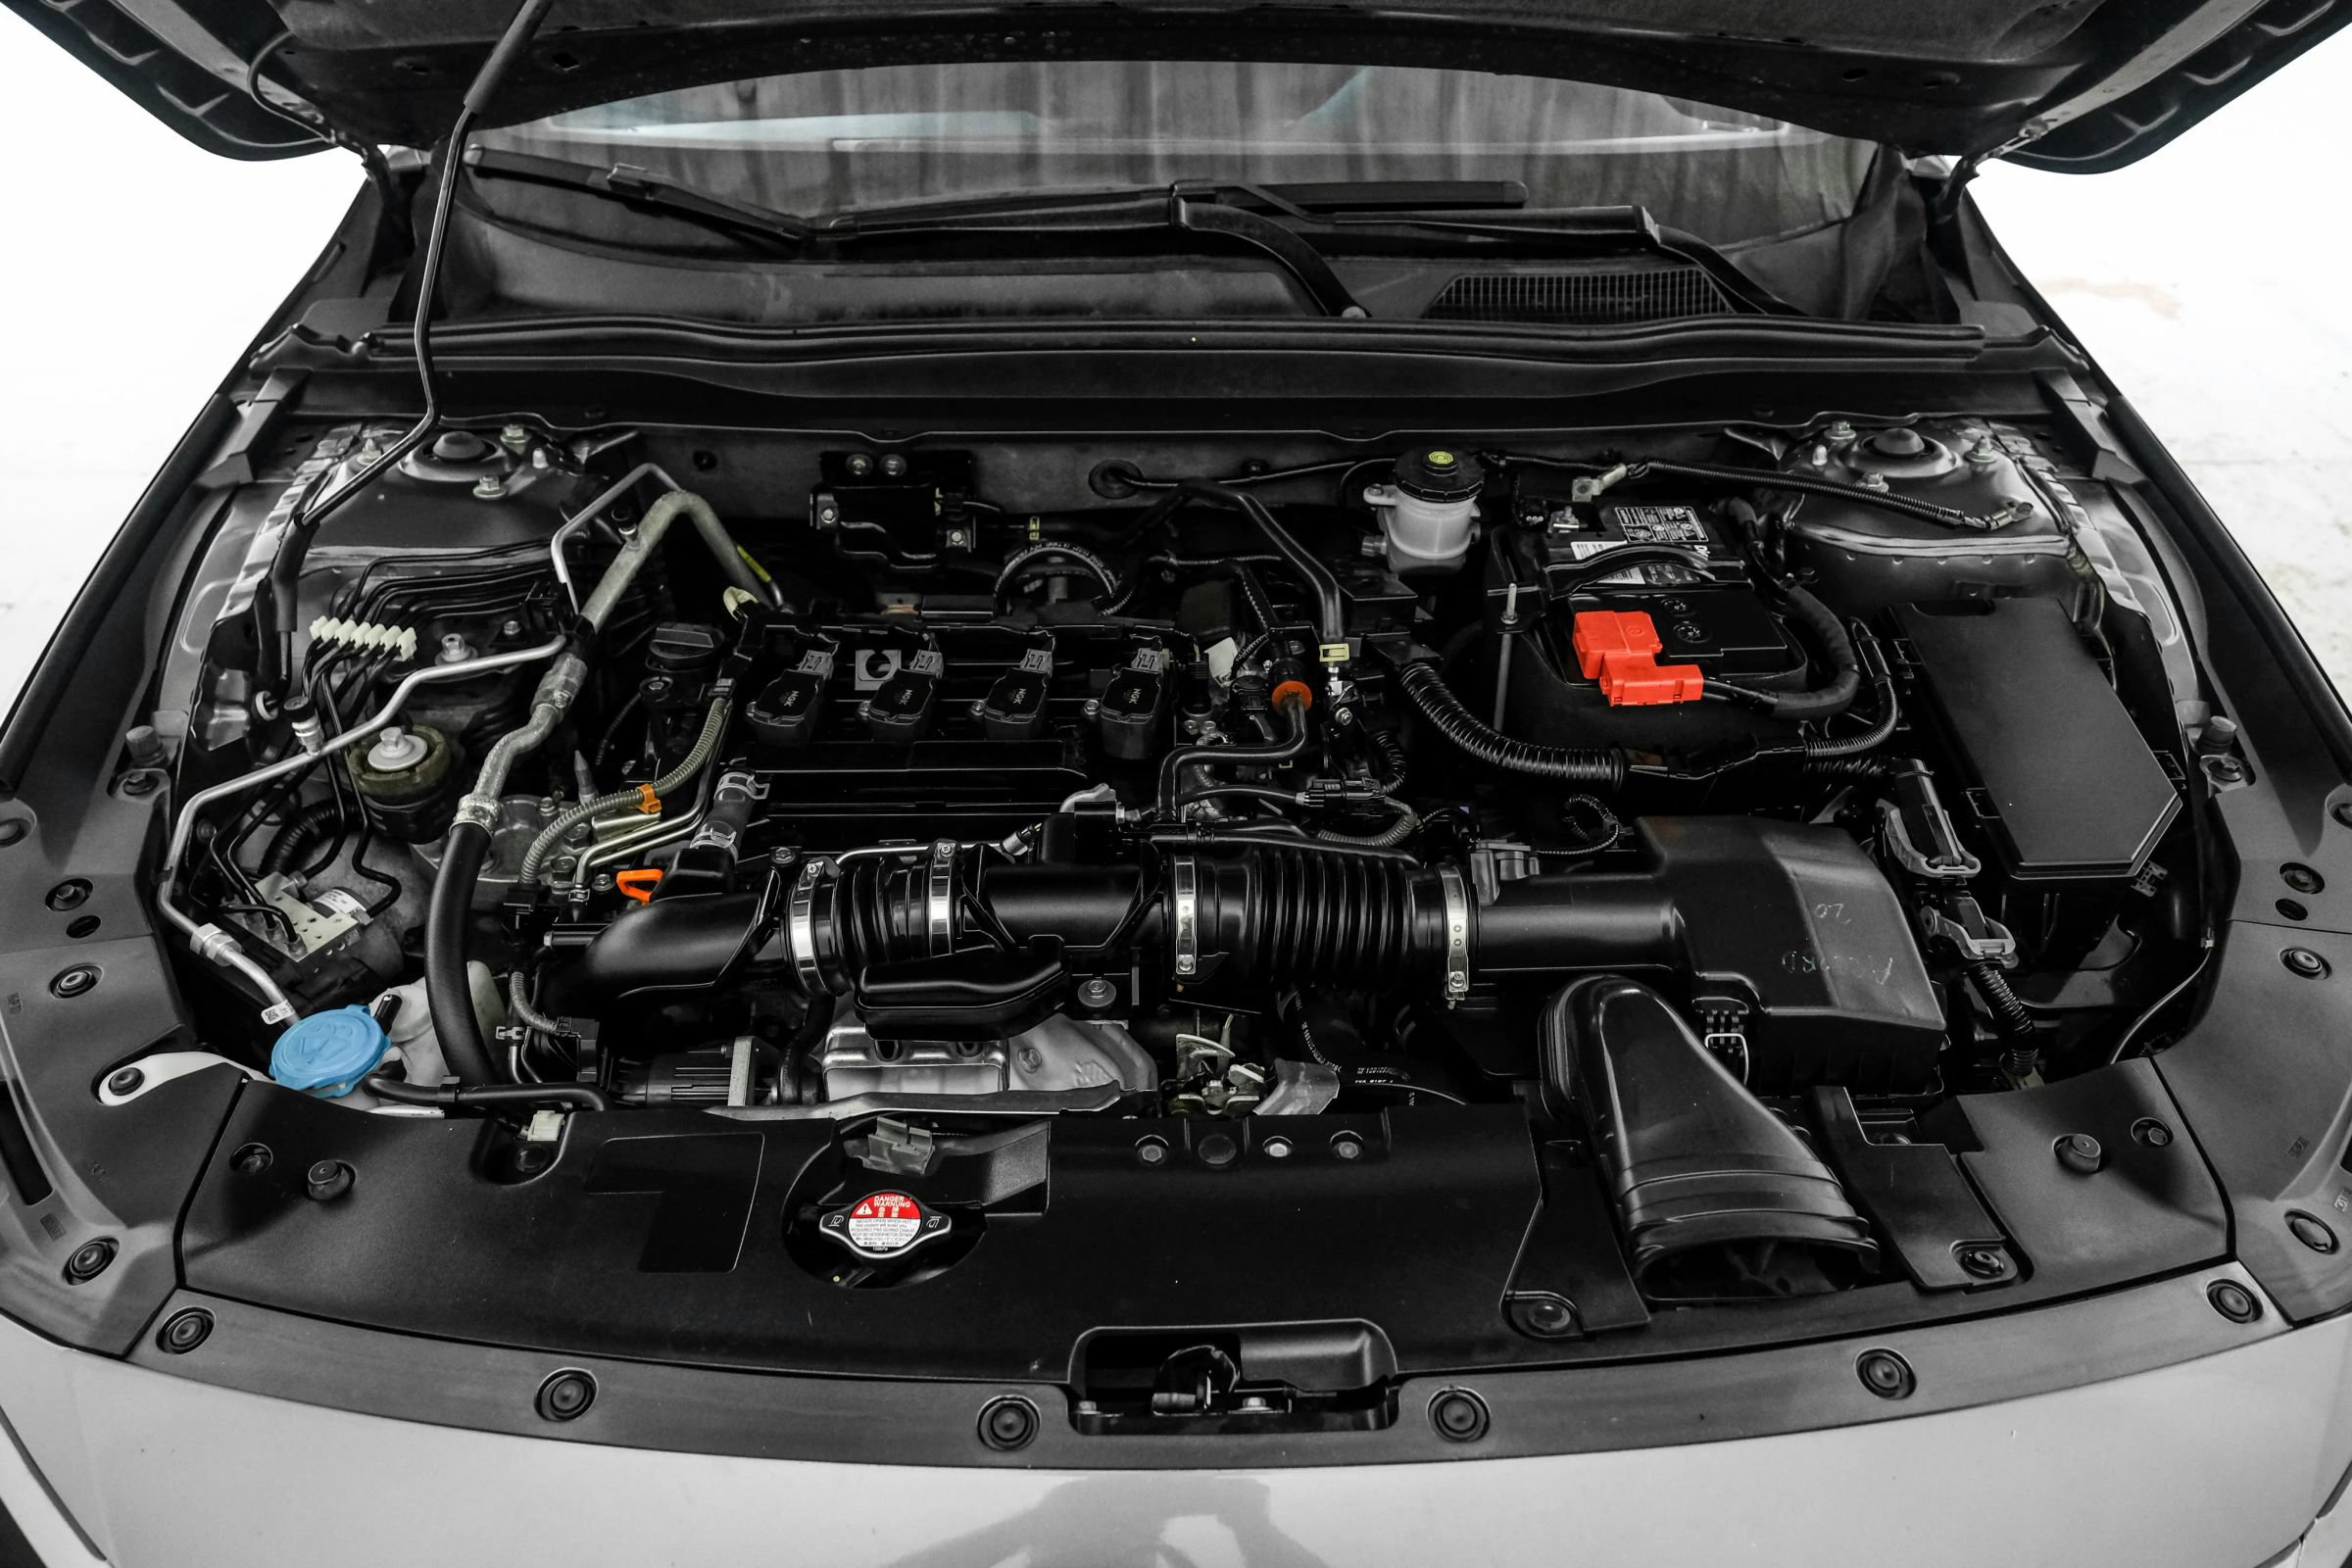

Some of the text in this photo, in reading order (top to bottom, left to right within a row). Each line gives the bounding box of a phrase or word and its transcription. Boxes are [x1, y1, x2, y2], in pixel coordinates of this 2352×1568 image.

[785, 690, 800, 706] NGK
[900, 689, 912, 706] NGK
[1012, 688, 1026, 705] NGK
[1129, 688, 1140, 705] NGK
